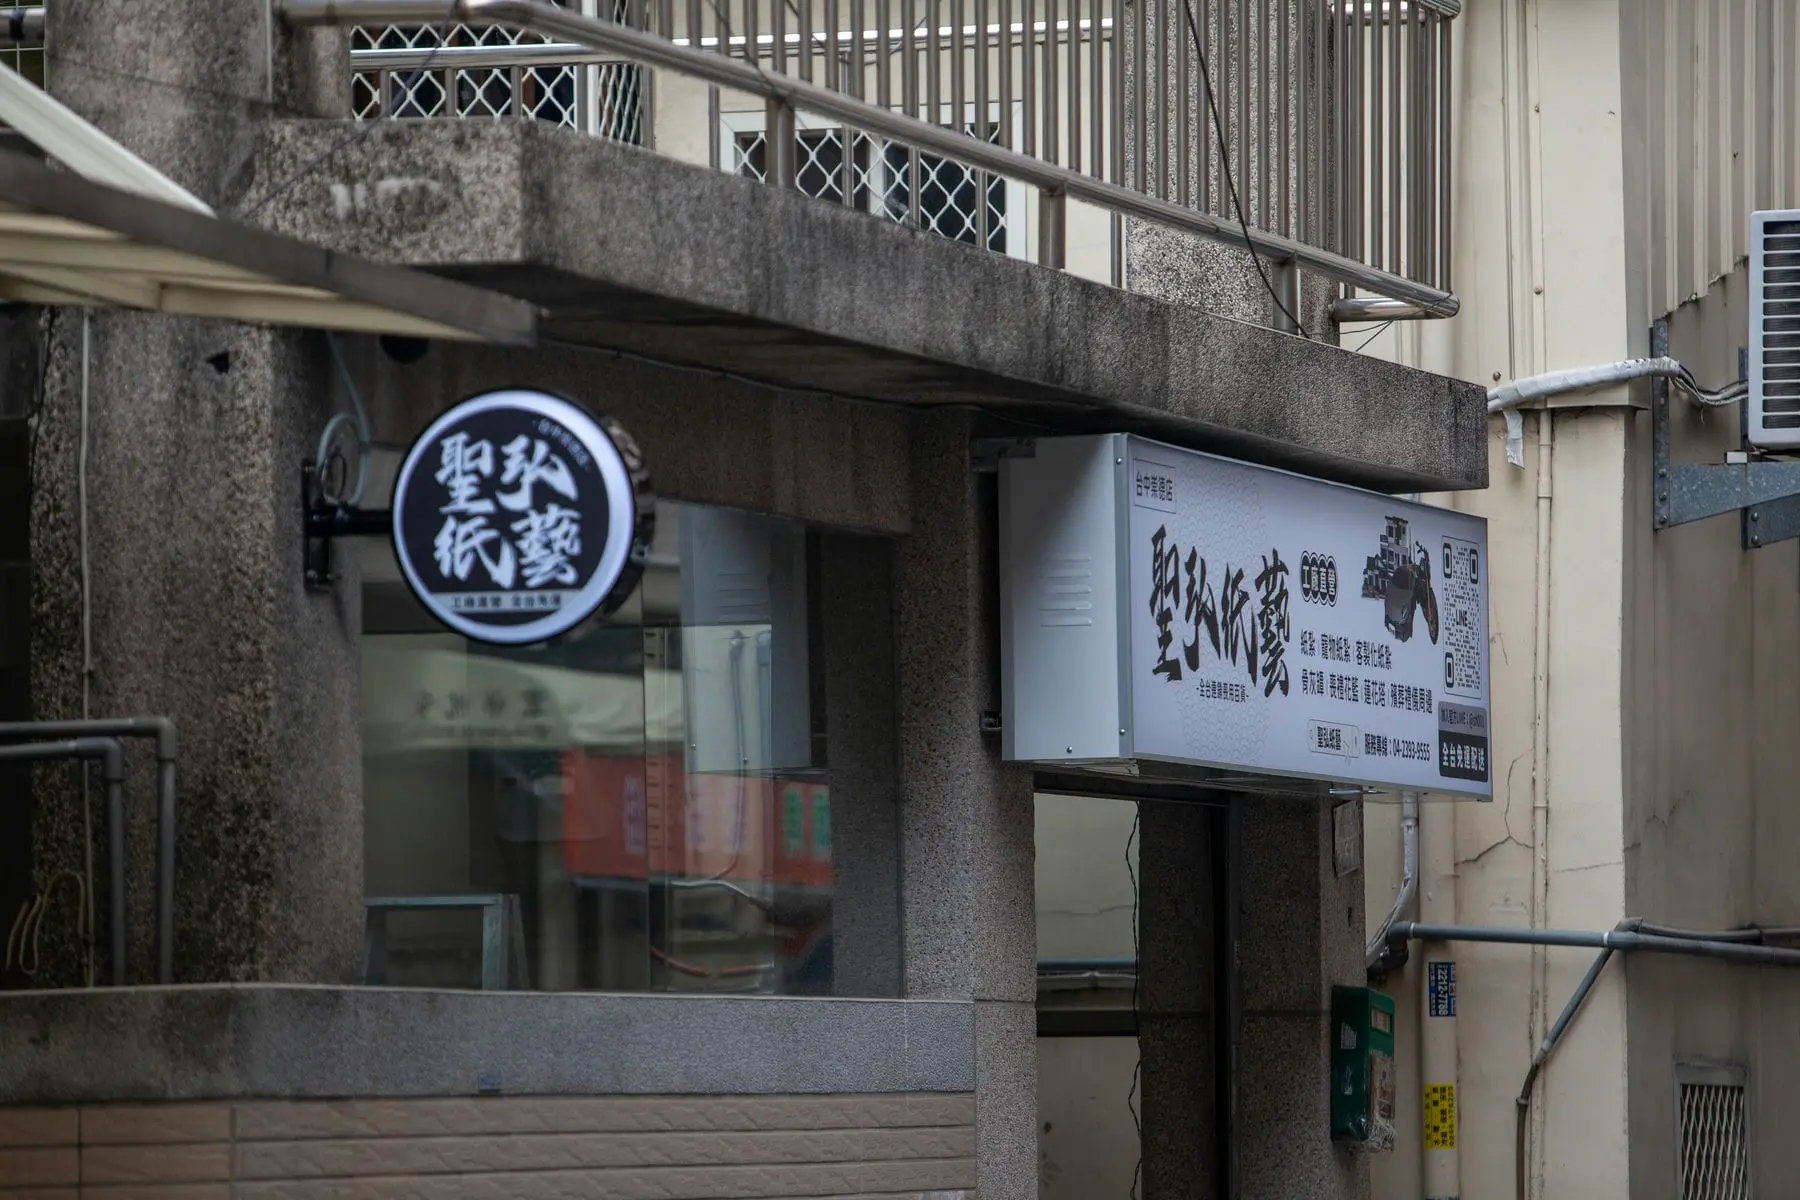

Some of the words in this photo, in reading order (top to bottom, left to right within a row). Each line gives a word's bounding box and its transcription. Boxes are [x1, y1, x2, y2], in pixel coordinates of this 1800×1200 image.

[1136, 470, 1173, 501] 台中崇德店
[1302, 565, 1336, 595] 工廠直營
[1149, 523, 1291, 698] 聖弘紙藝
[1442, 742, 1485, 771] 全台免運配送
